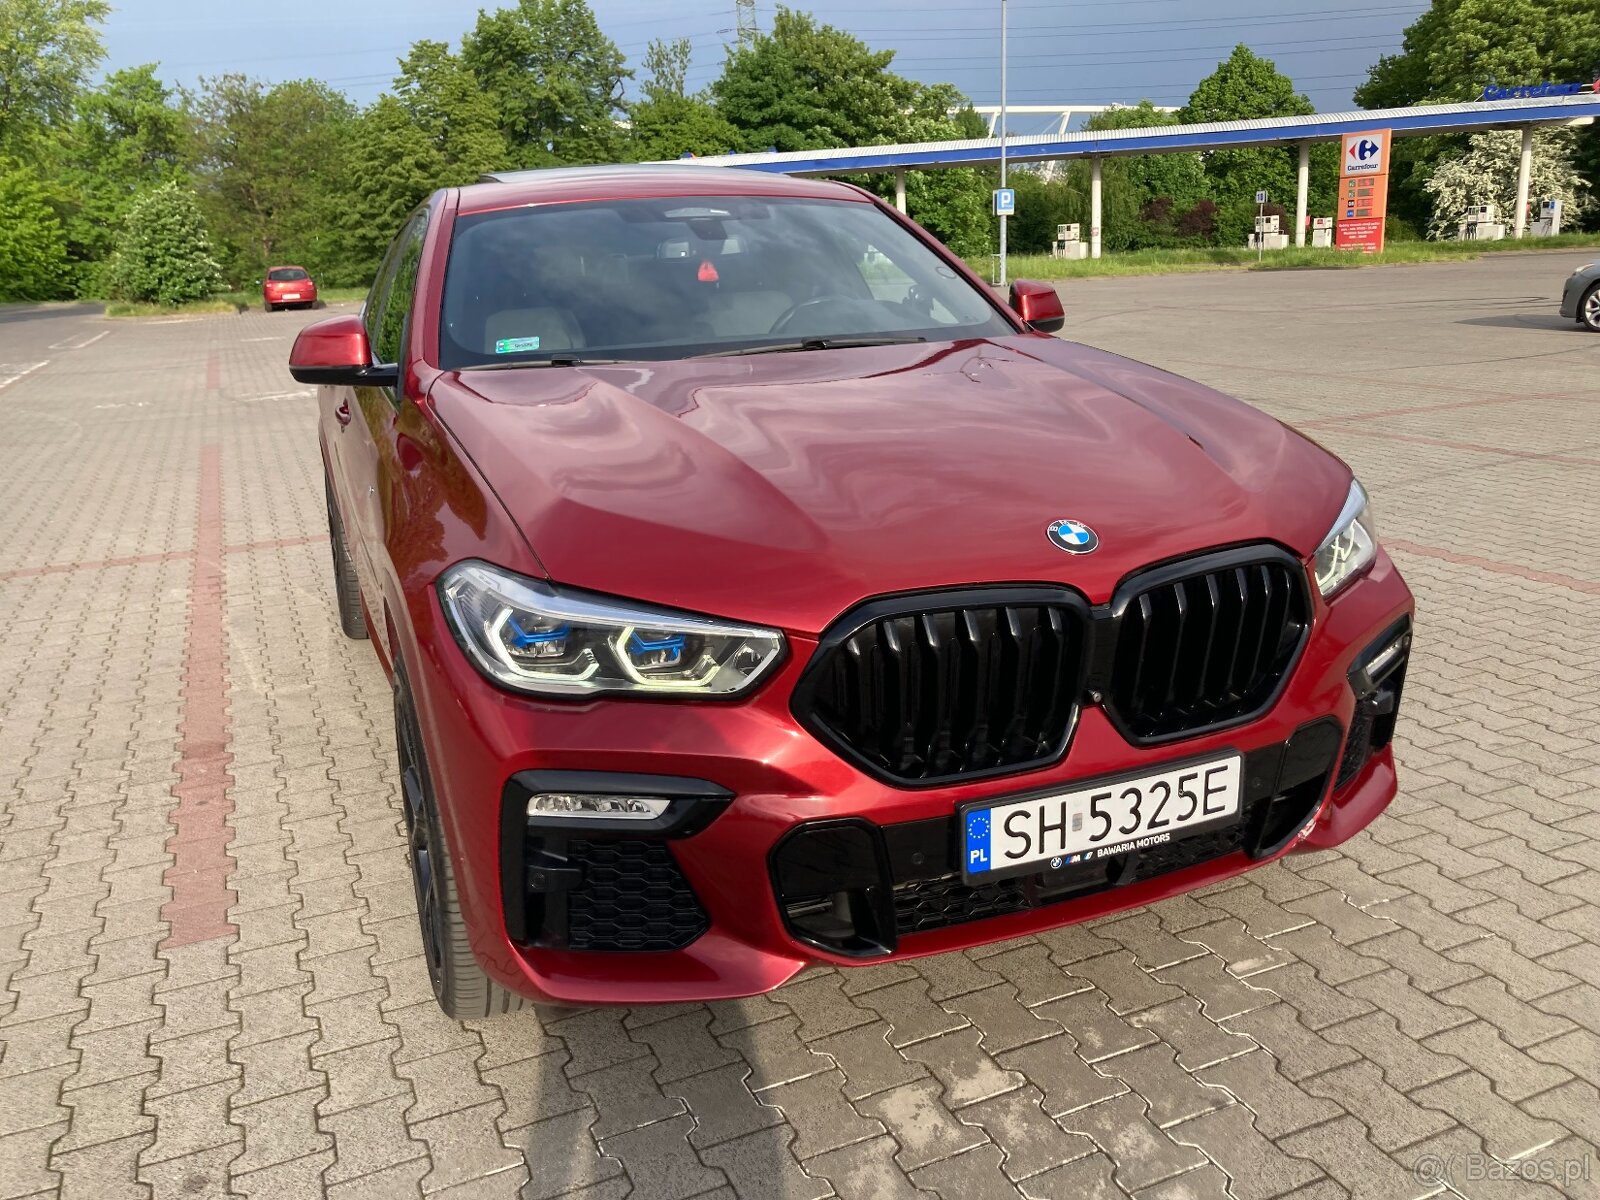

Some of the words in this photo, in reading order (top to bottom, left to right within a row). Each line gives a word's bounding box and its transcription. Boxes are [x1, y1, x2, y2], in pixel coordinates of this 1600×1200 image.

[1484, 81, 1583, 101] Carrefour
[1001, 192, 1011, 208] P
[1003, 801, 1067, 859] SH
[1089, 765, 1229, 842] 5325E
[1097, 842, 1135, 858] BAWARIA
[1136, 833, 1170, 848] MOTORS
[970, 849, 988, 864] PL
